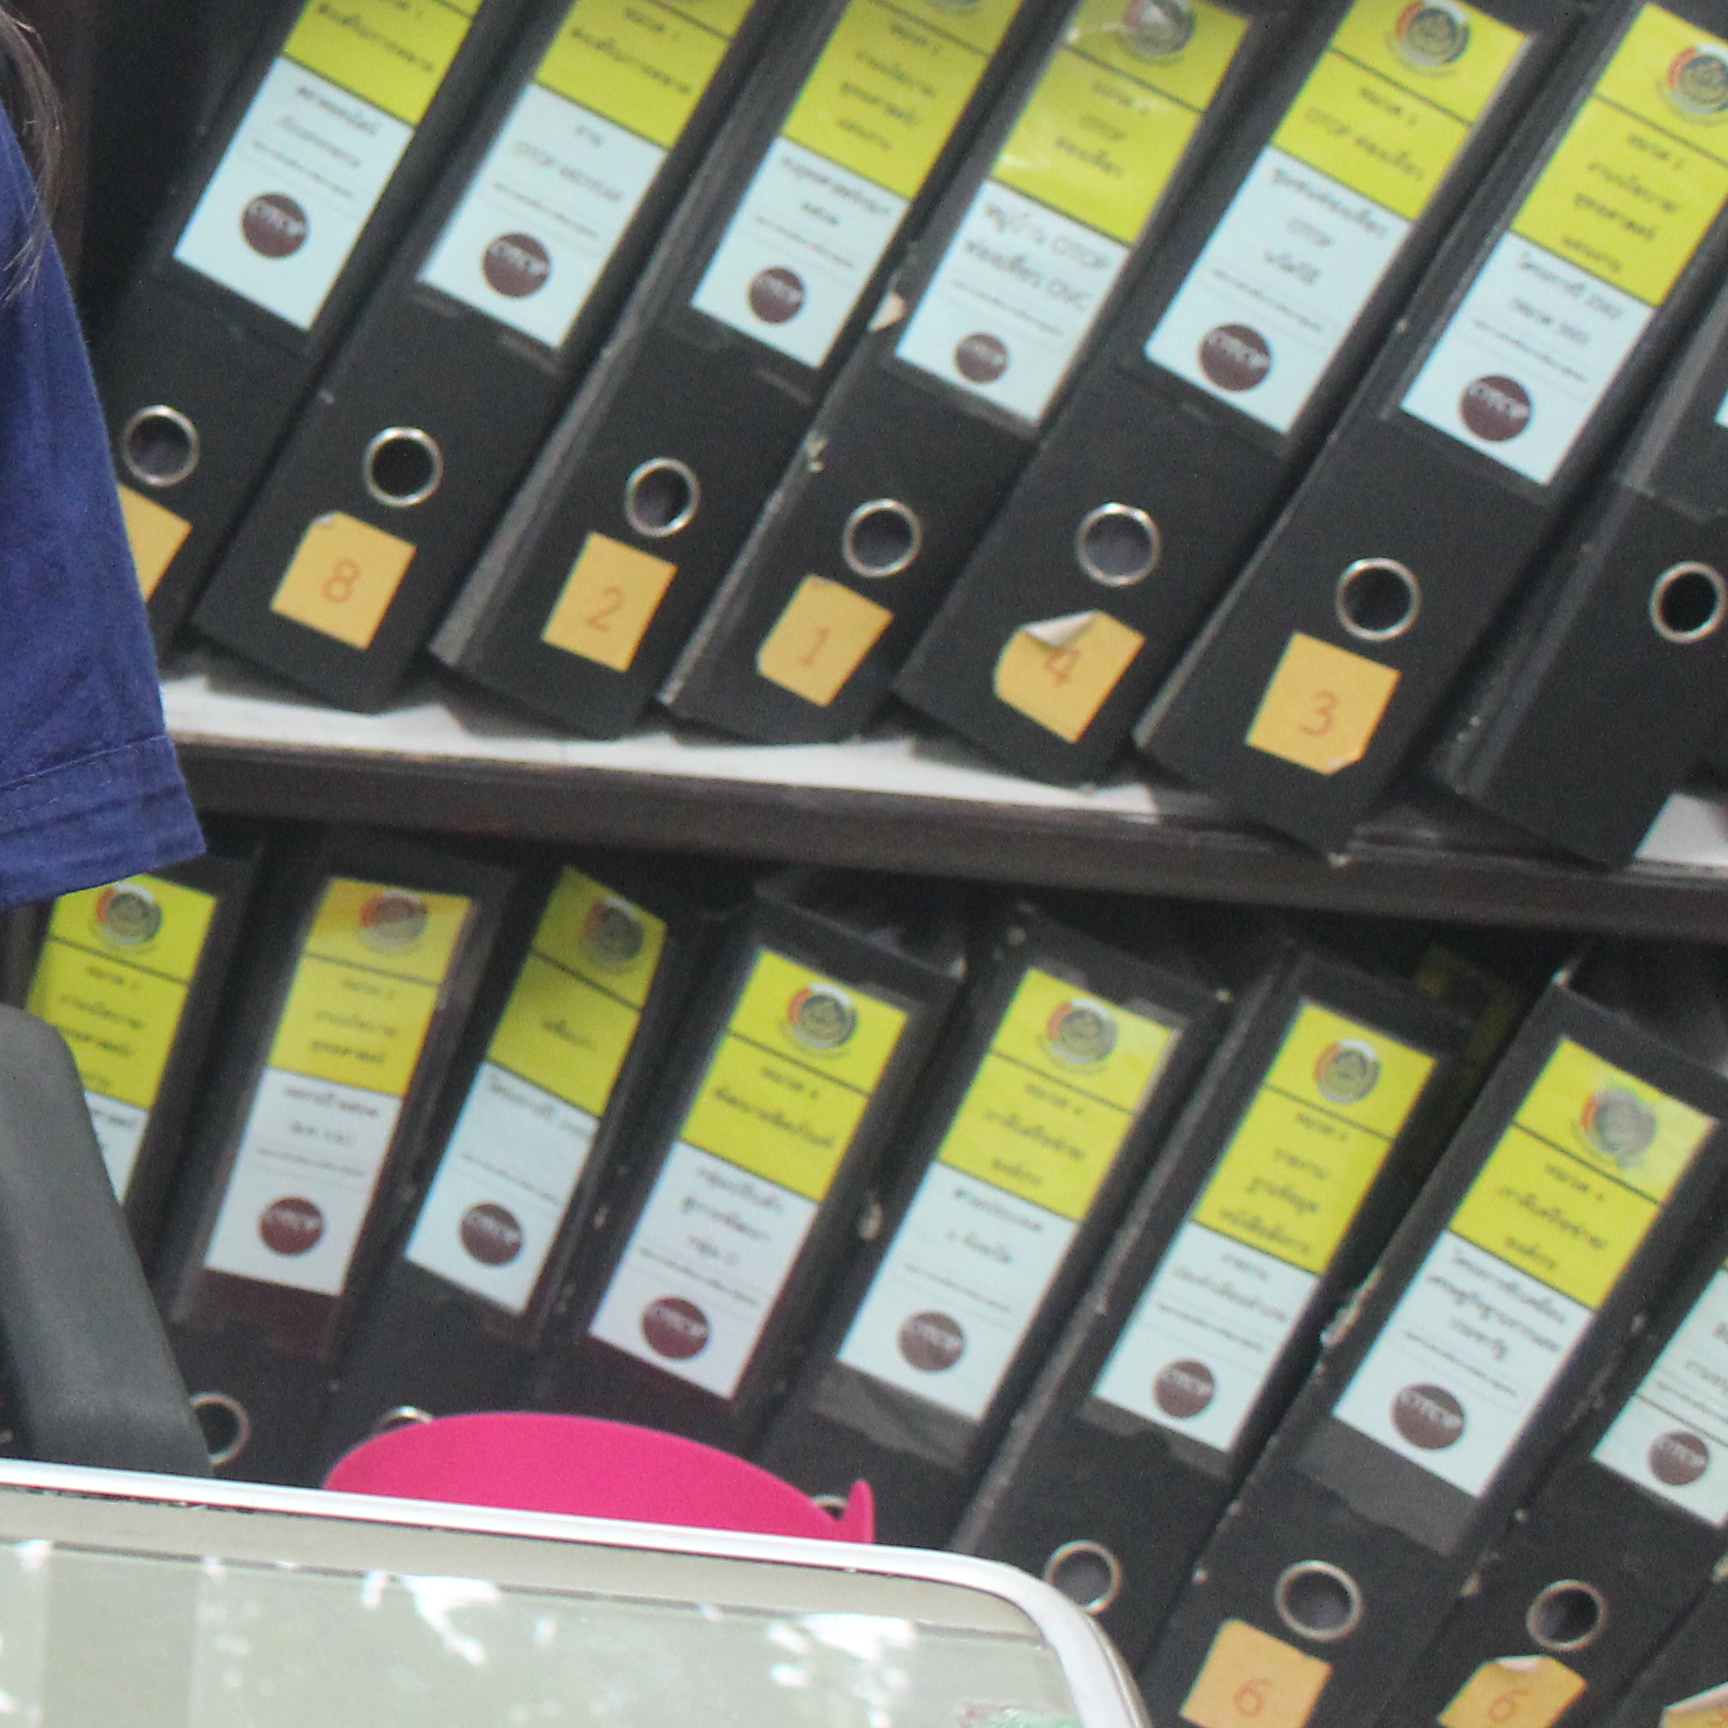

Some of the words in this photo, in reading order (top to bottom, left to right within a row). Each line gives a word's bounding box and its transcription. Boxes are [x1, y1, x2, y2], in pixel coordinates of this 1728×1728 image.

[322, 558, 361, 604] 8
[585, 587, 625, 632] 2
[799, 626, 831, 668] 1
[1299, 690, 1339, 737] 3
[1234, 1678, 1272, 1716] 6
[1489, 1688, 1528, 1722] 6
